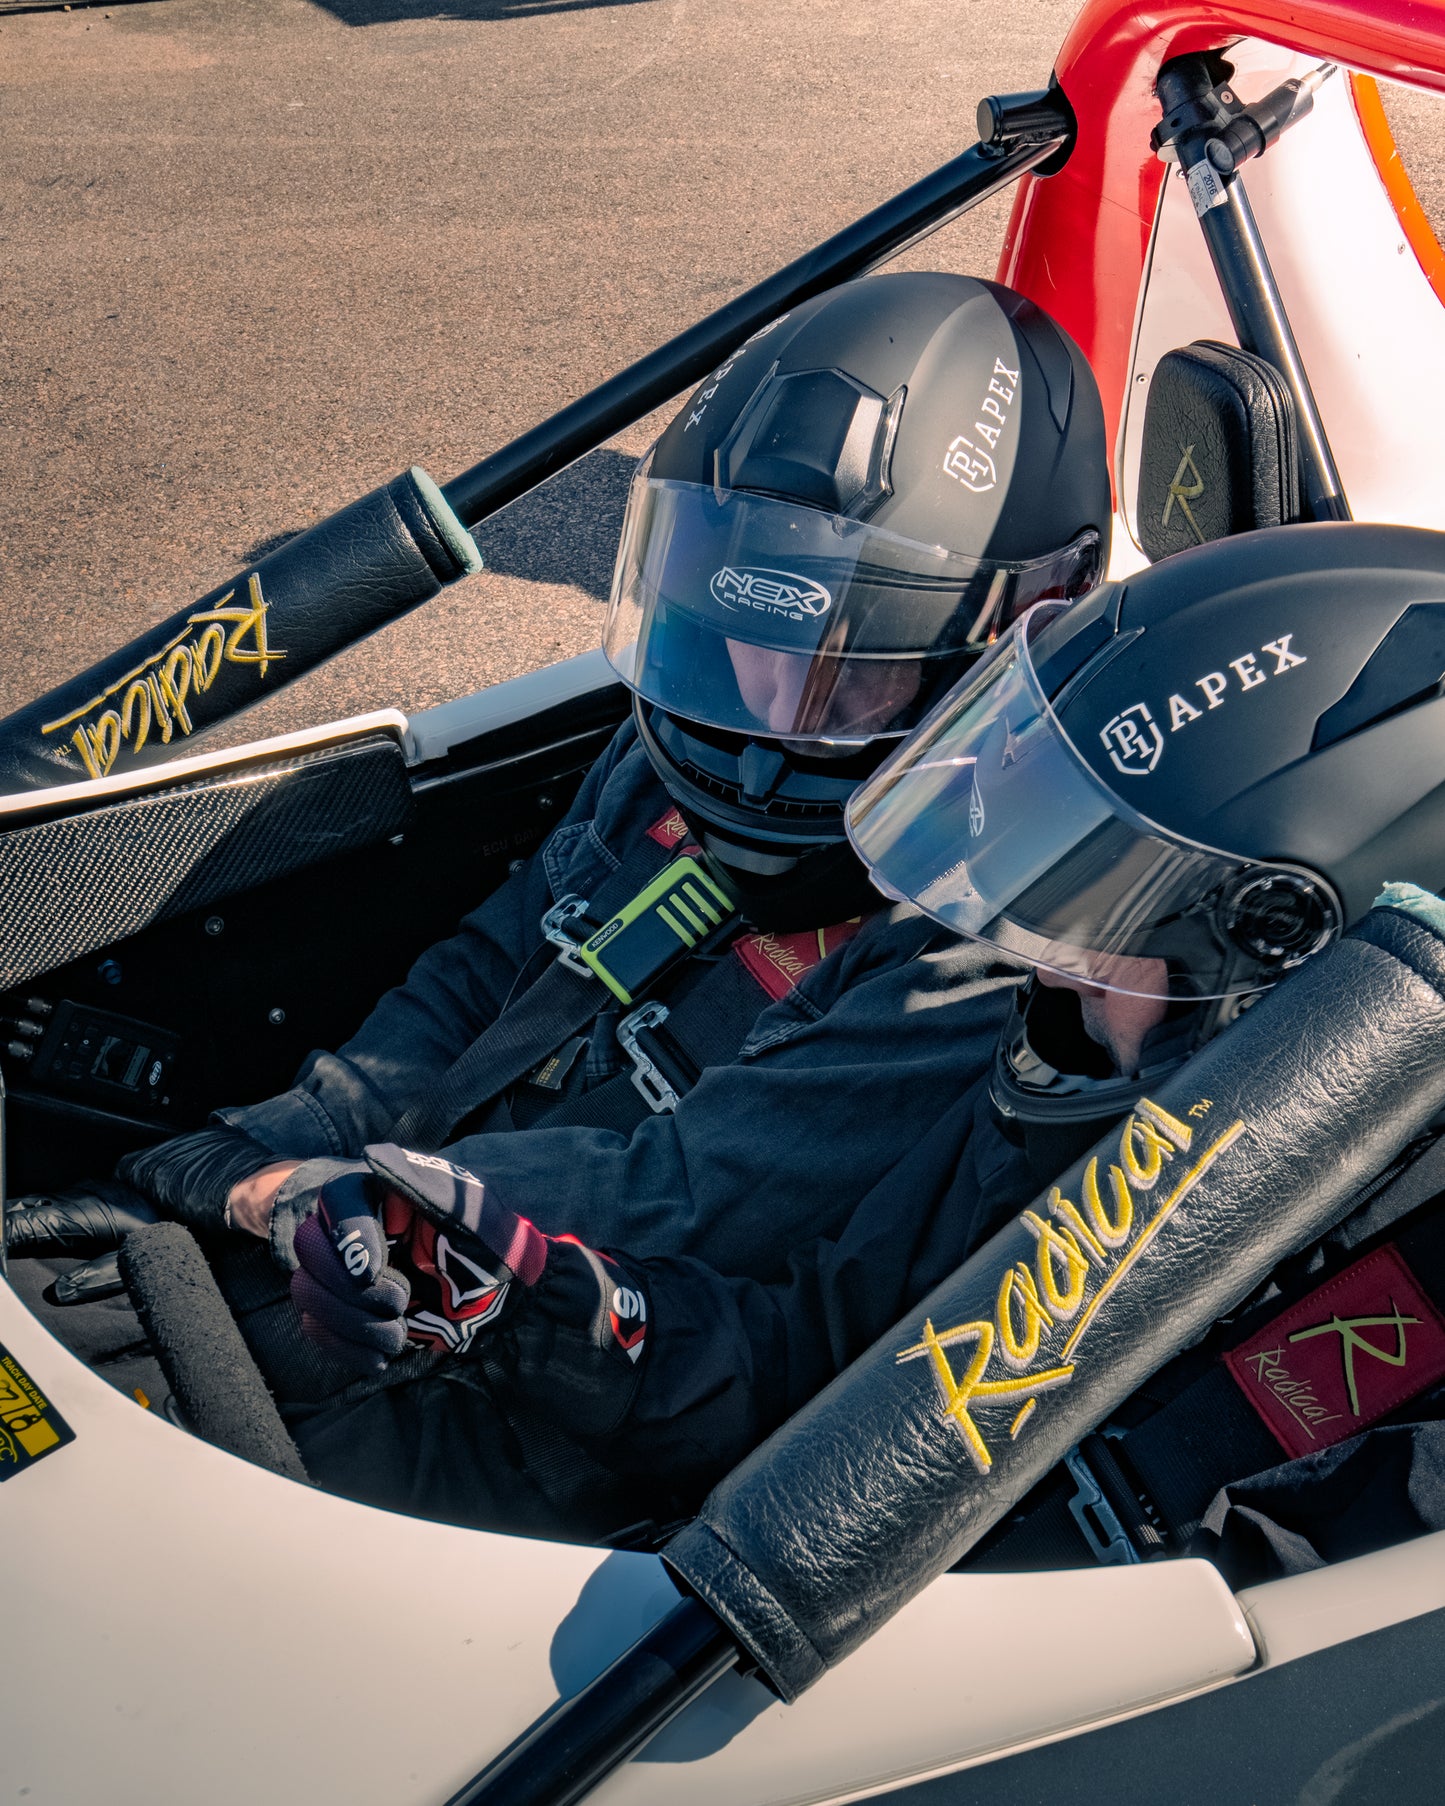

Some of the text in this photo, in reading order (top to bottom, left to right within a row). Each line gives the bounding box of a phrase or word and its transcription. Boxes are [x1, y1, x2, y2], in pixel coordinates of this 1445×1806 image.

[1204, 174, 1218, 195] 2016
[975, 357, 1019, 449] APEX
[716, 566, 827, 615] NEX
[723, 591, 804, 621] RACING
[72, 572, 288, 779] Radical
[1161, 633, 1308, 732] APEX
[592, 922, 619, 948] KENWOOD
[751, 932, 815, 977] Radical
[896, 1098, 1193, 1475] Radical
[2, 1356, 48, 1410] TRACK DAY DATE
[1245, 1345, 1343, 1426] Radical
